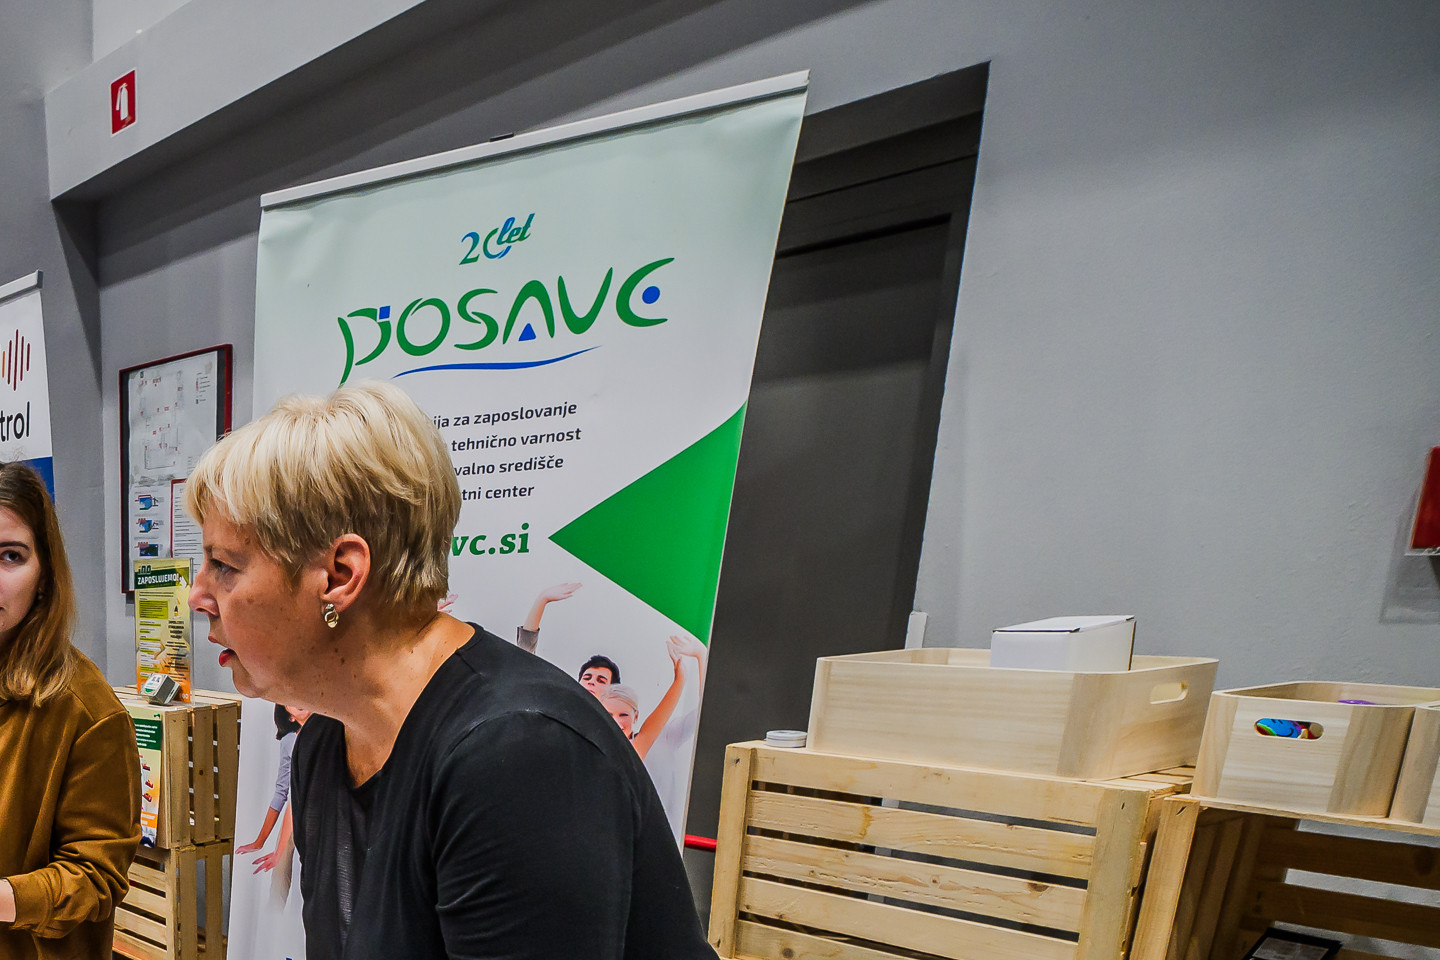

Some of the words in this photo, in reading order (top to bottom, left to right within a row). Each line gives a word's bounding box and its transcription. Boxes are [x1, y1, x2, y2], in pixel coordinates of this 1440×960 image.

[337, 257, 675, 388] POSAVC
[433, 415, 450, 430] ija
[453, 415, 471, 427] za
[474, 403, 577, 425] zaposlovanje
[451, 433, 517, 452] tehnično
[521, 427, 581, 446] varnost
[499, 456, 564, 473] središče
[485, 484, 535, 499] center
